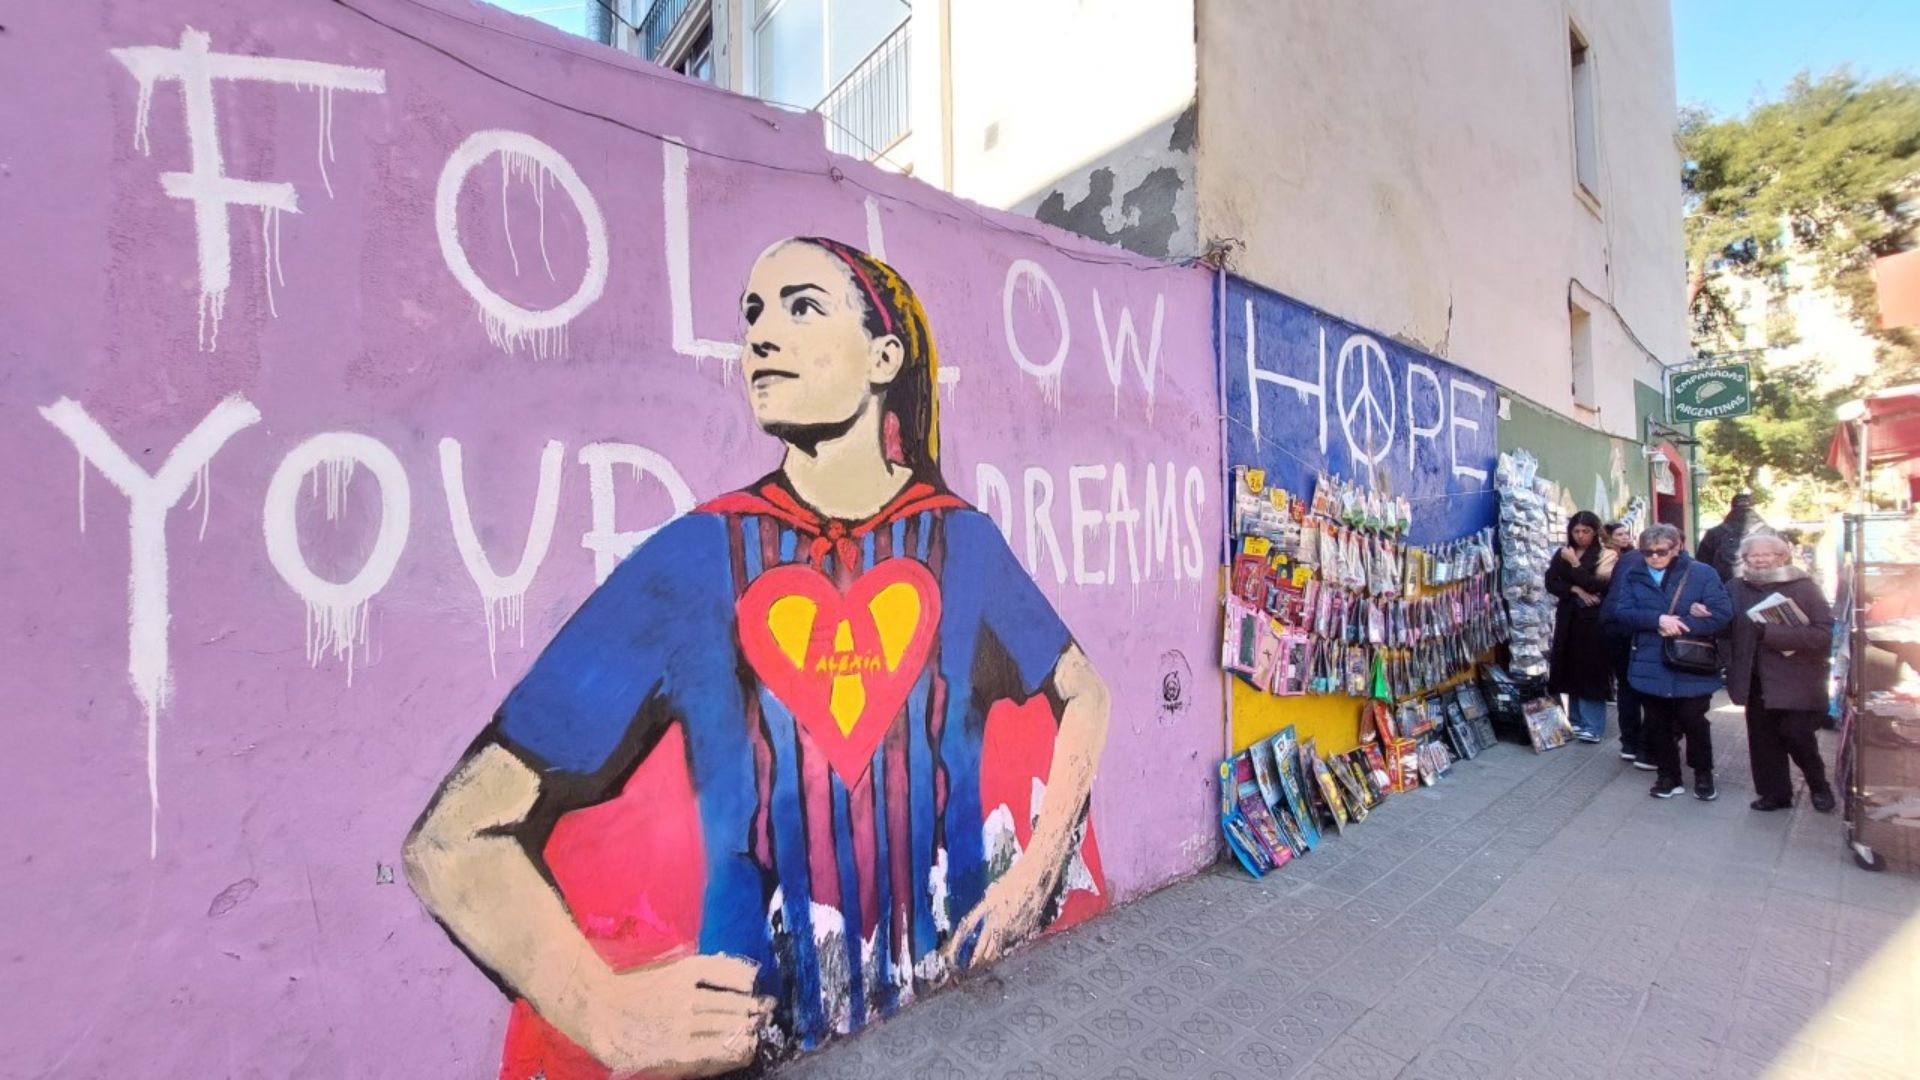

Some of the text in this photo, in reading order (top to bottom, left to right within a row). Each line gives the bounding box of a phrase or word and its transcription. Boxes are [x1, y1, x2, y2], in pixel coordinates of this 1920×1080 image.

[1245, 298, 1488, 481] HOPE
[1674, 369, 1745, 394] EMPANADAS
[1676, 394, 1745, 417] ARGENTINAS
[976, 461, 1206, 586] DREAMS
